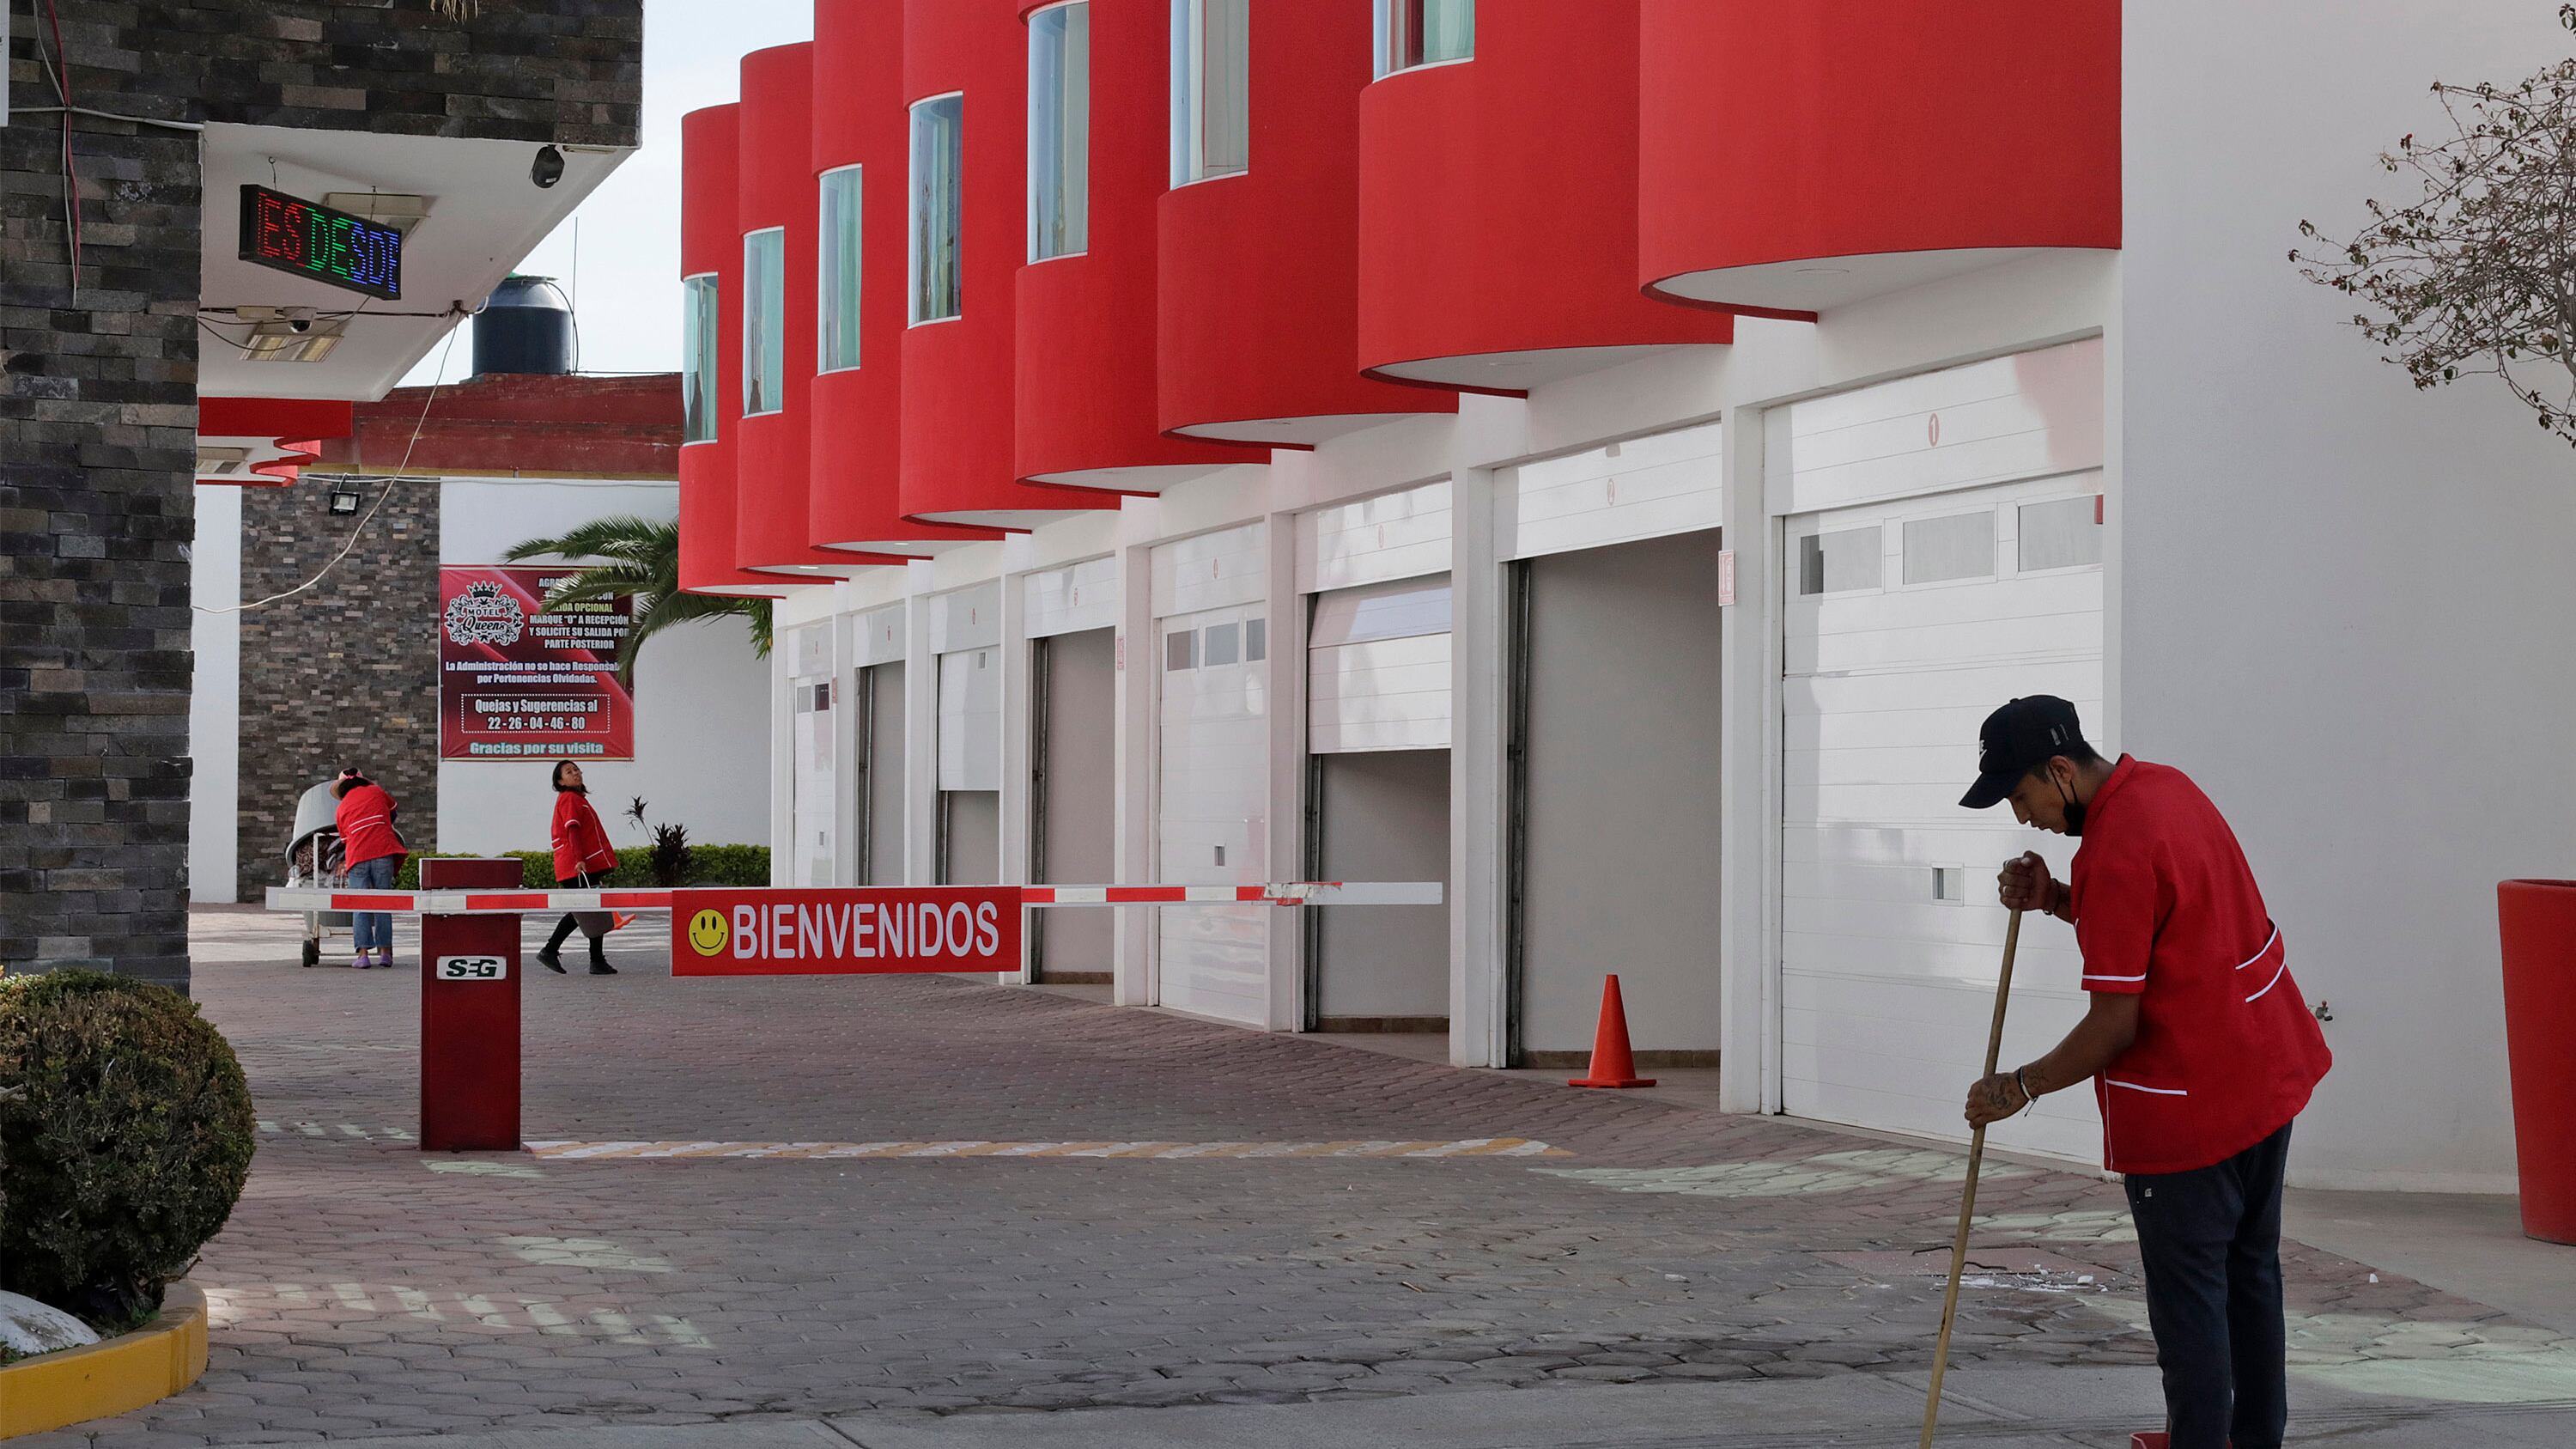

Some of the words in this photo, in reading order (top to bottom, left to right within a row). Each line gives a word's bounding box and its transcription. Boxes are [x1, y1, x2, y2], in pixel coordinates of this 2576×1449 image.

[574, 603, 613, 612] OPCIONAL
[463, 616, 505, 633] Queens
[530, 615, 562, 624] MARQUE
[578, 615, 584, 624] A
[585, 614, 629, 625] RECEPCIÓN
[529, 627, 534, 636] Y
[536, 627, 571, 636] SOLICITE
[572, 627, 583, 636] SU
[584, 627, 611, 636] SALIDA
[544, 640, 569, 648] PARTE
[570, 640, 614, 648] POSTERIOR
[446, 661, 455, 671] La
[457, 661, 523, 671] Administración
[525, 662, 536, 671] no
[537, 662, 548, 671] se
[550, 661, 571, 671] hace
[477, 674, 493, 684] por
[493, 673, 551, 683] Pertenencias
[552, 673, 597, 683] Olvidadas.
[475, 699, 511, 713] Quejas
[513, 701, 519, 713] y
[520, 699, 586, 713] Sugerencias
[587, 699, 598, 712] al
[470, 742, 521, 754] Gracias
[524, 744, 546, 755] por
[548, 744, 565, 754] su
[567, 742, 604, 754] visita
[732, 901, 999, 959] BIENVENIDOS
